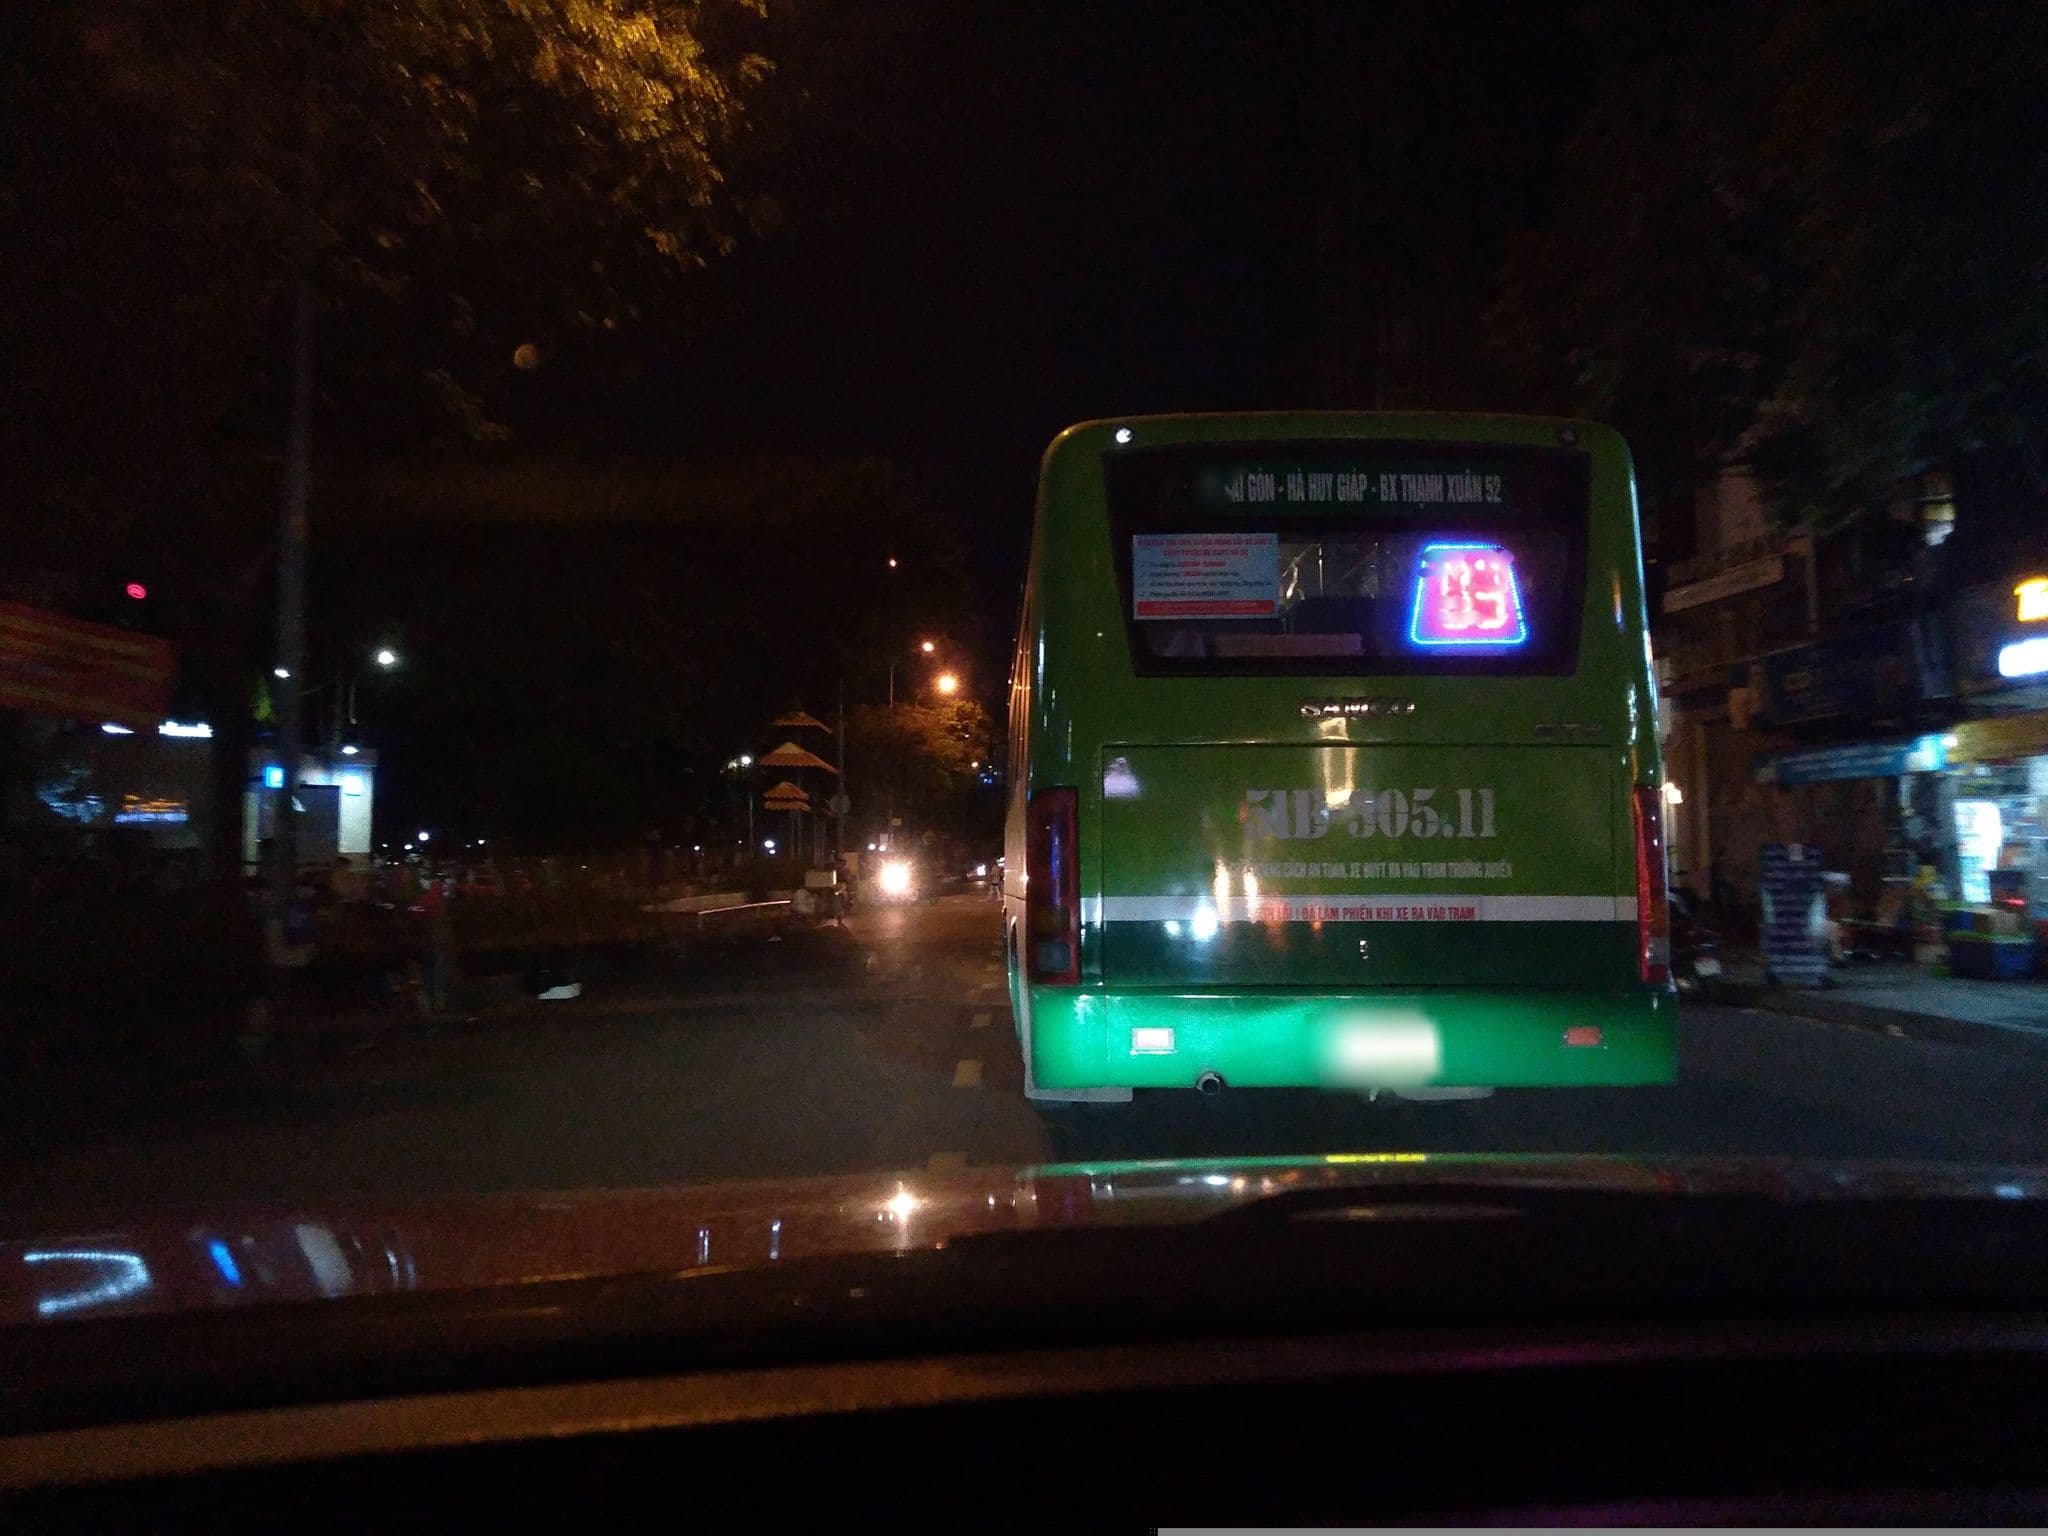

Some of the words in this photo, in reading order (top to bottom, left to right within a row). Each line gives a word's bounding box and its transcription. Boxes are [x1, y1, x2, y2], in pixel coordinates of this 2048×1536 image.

[1309, 472, 1333, 503] HUY
[1337, 466, 1368, 503] GIÁP
[1396, 907, 1408, 920] XE
